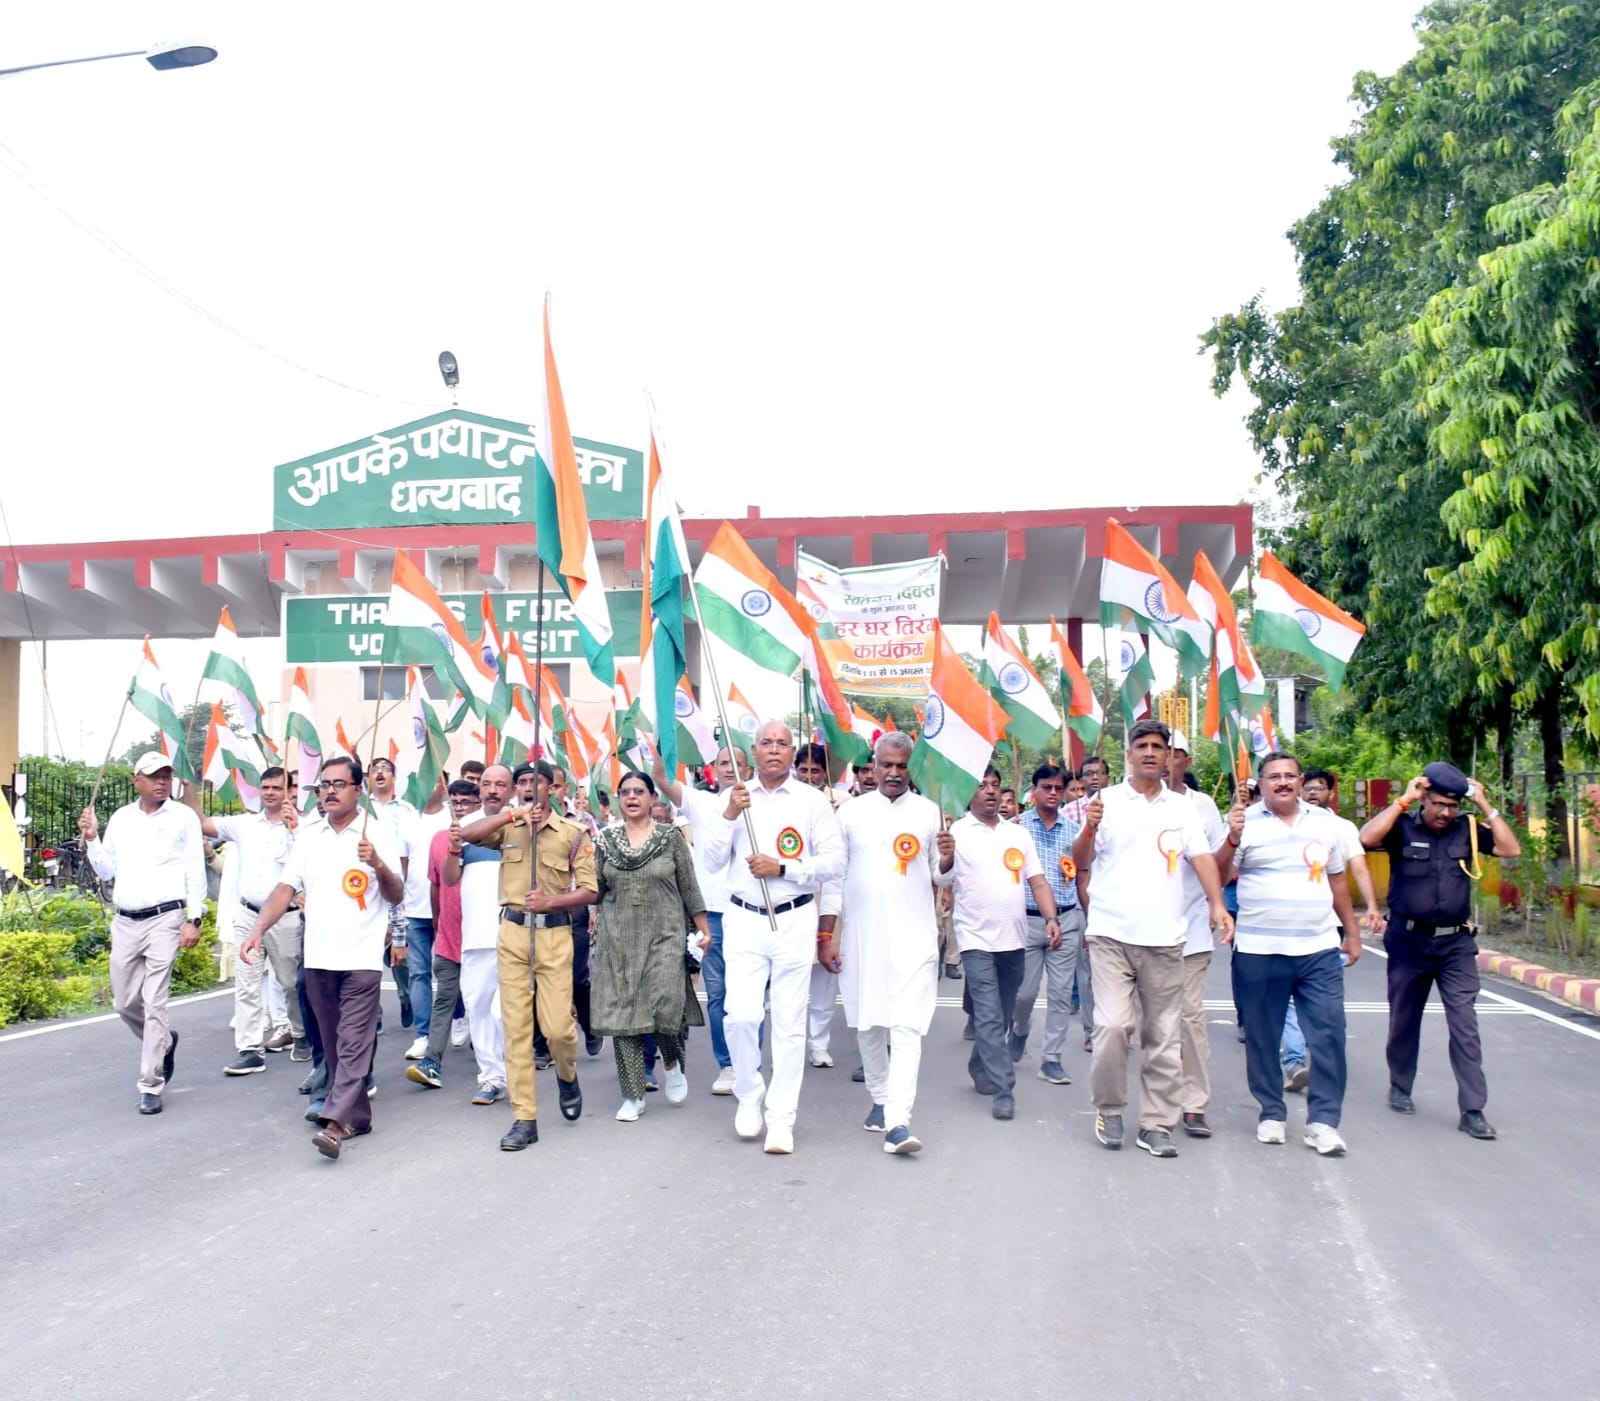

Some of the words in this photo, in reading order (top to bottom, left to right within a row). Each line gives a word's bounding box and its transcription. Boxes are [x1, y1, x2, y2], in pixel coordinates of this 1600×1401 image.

[288, 435, 407, 507] आपके
[576, 447, 627, 492] का
[390, 475, 522, 517] धन्यवाद
[327, 600, 466, 625] THAS
[506, 598, 577, 622] FOR
[834, 621, 859, 637] हर
[864, 621, 891, 636] घर
[854, 640, 924, 659] कार्यक्रम
[880, 667, 887, 676] से
[899, 667, 924, 676] अगस्त
